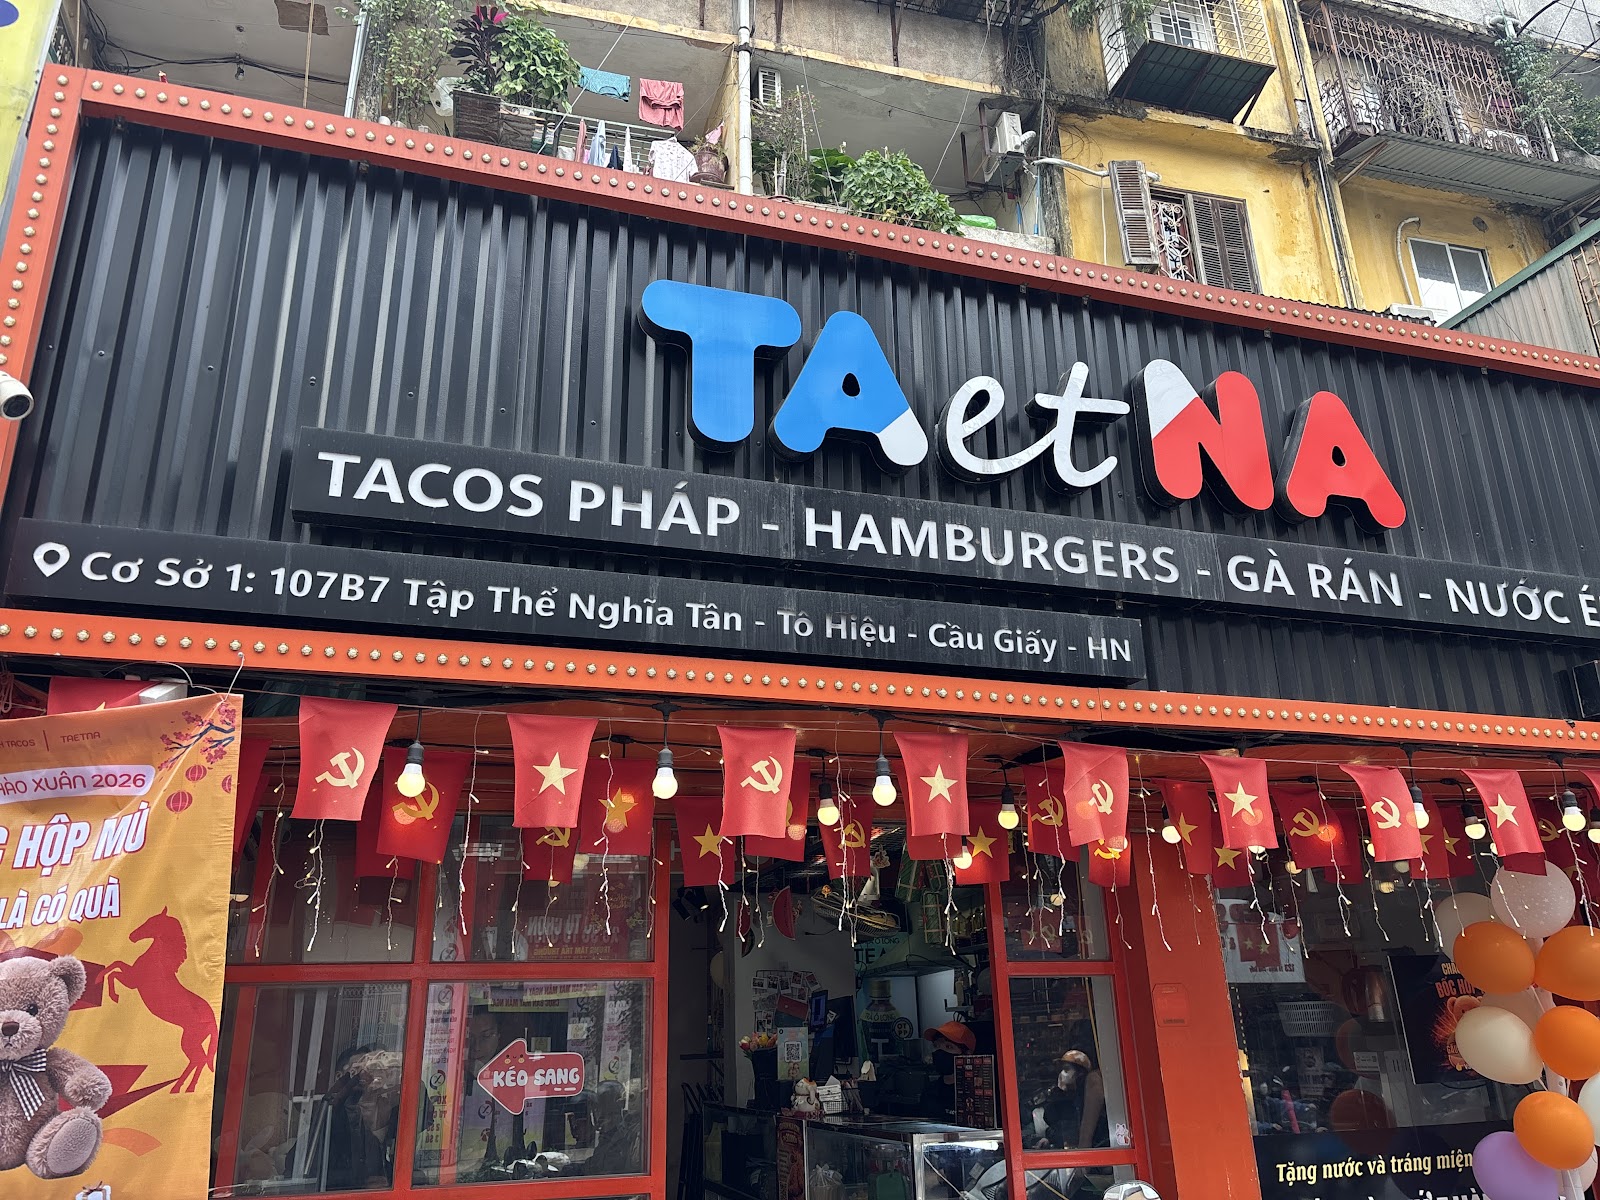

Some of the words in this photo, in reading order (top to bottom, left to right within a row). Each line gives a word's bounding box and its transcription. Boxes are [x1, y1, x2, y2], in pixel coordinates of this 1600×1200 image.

[638, 278, 1407, 530] TAetNA
[317, 451, 545, 517] TACOS
[568, 480, 740, 537] PHÁP
[761, 521, 780, 532] -
[805, 507, 1180, 584] HAMBURGERS
[1197, 568, 1211, 577] -
[1227, 548, 1296, 597] GÀ
[1306, 557, 1404, 607] RÁN
[1418, 592, 1432, 600] -
[1445, 577, 1571, 625] NƯỚC
[1580, 584, 1600, 627] É
[81, 551, 145, 584] Cơ
[155, 557, 214, 589] Sở
[225, 563, 256, 594] 1:
[270, 566, 391, 603] 107B7
[403, 578, 475, 618] Tập
[487, 585, 560, 617] Thể
[568, 593, 675, 630] Nghĩa
[685, 601, 743, 632] Tân
[776, 608, 815, 638] Tô
[825, 611, 897, 648] Hiệu
[927, 620, 985, 651] Cầu
[993, 628, 1058, 663] Giấy
[1087, 636, 1132, 662] HN
[7, 737, 36, 748] TACOS
[60, 731, 101, 744] TAETNA
[32, 770, 87, 793] XUÂN
[91, 773, 147, 789] 2026
[12, 813, 92, 878] HỘP
[30, 883, 69, 927] CÓ
[68, 874, 121, 924] QUÀ
[493, 1066, 528, 1088] KÉO
[533, 1067, 580, 1086] SANG
[1276, 1161, 1318, 1187] Tặng
[1322, 1157, 1363, 1179] nước
[1367, 1154, 1387, 1176] và
[1390, 1152, 1432, 1176] tráng
[1436, 1148, 1474, 1174] miện
